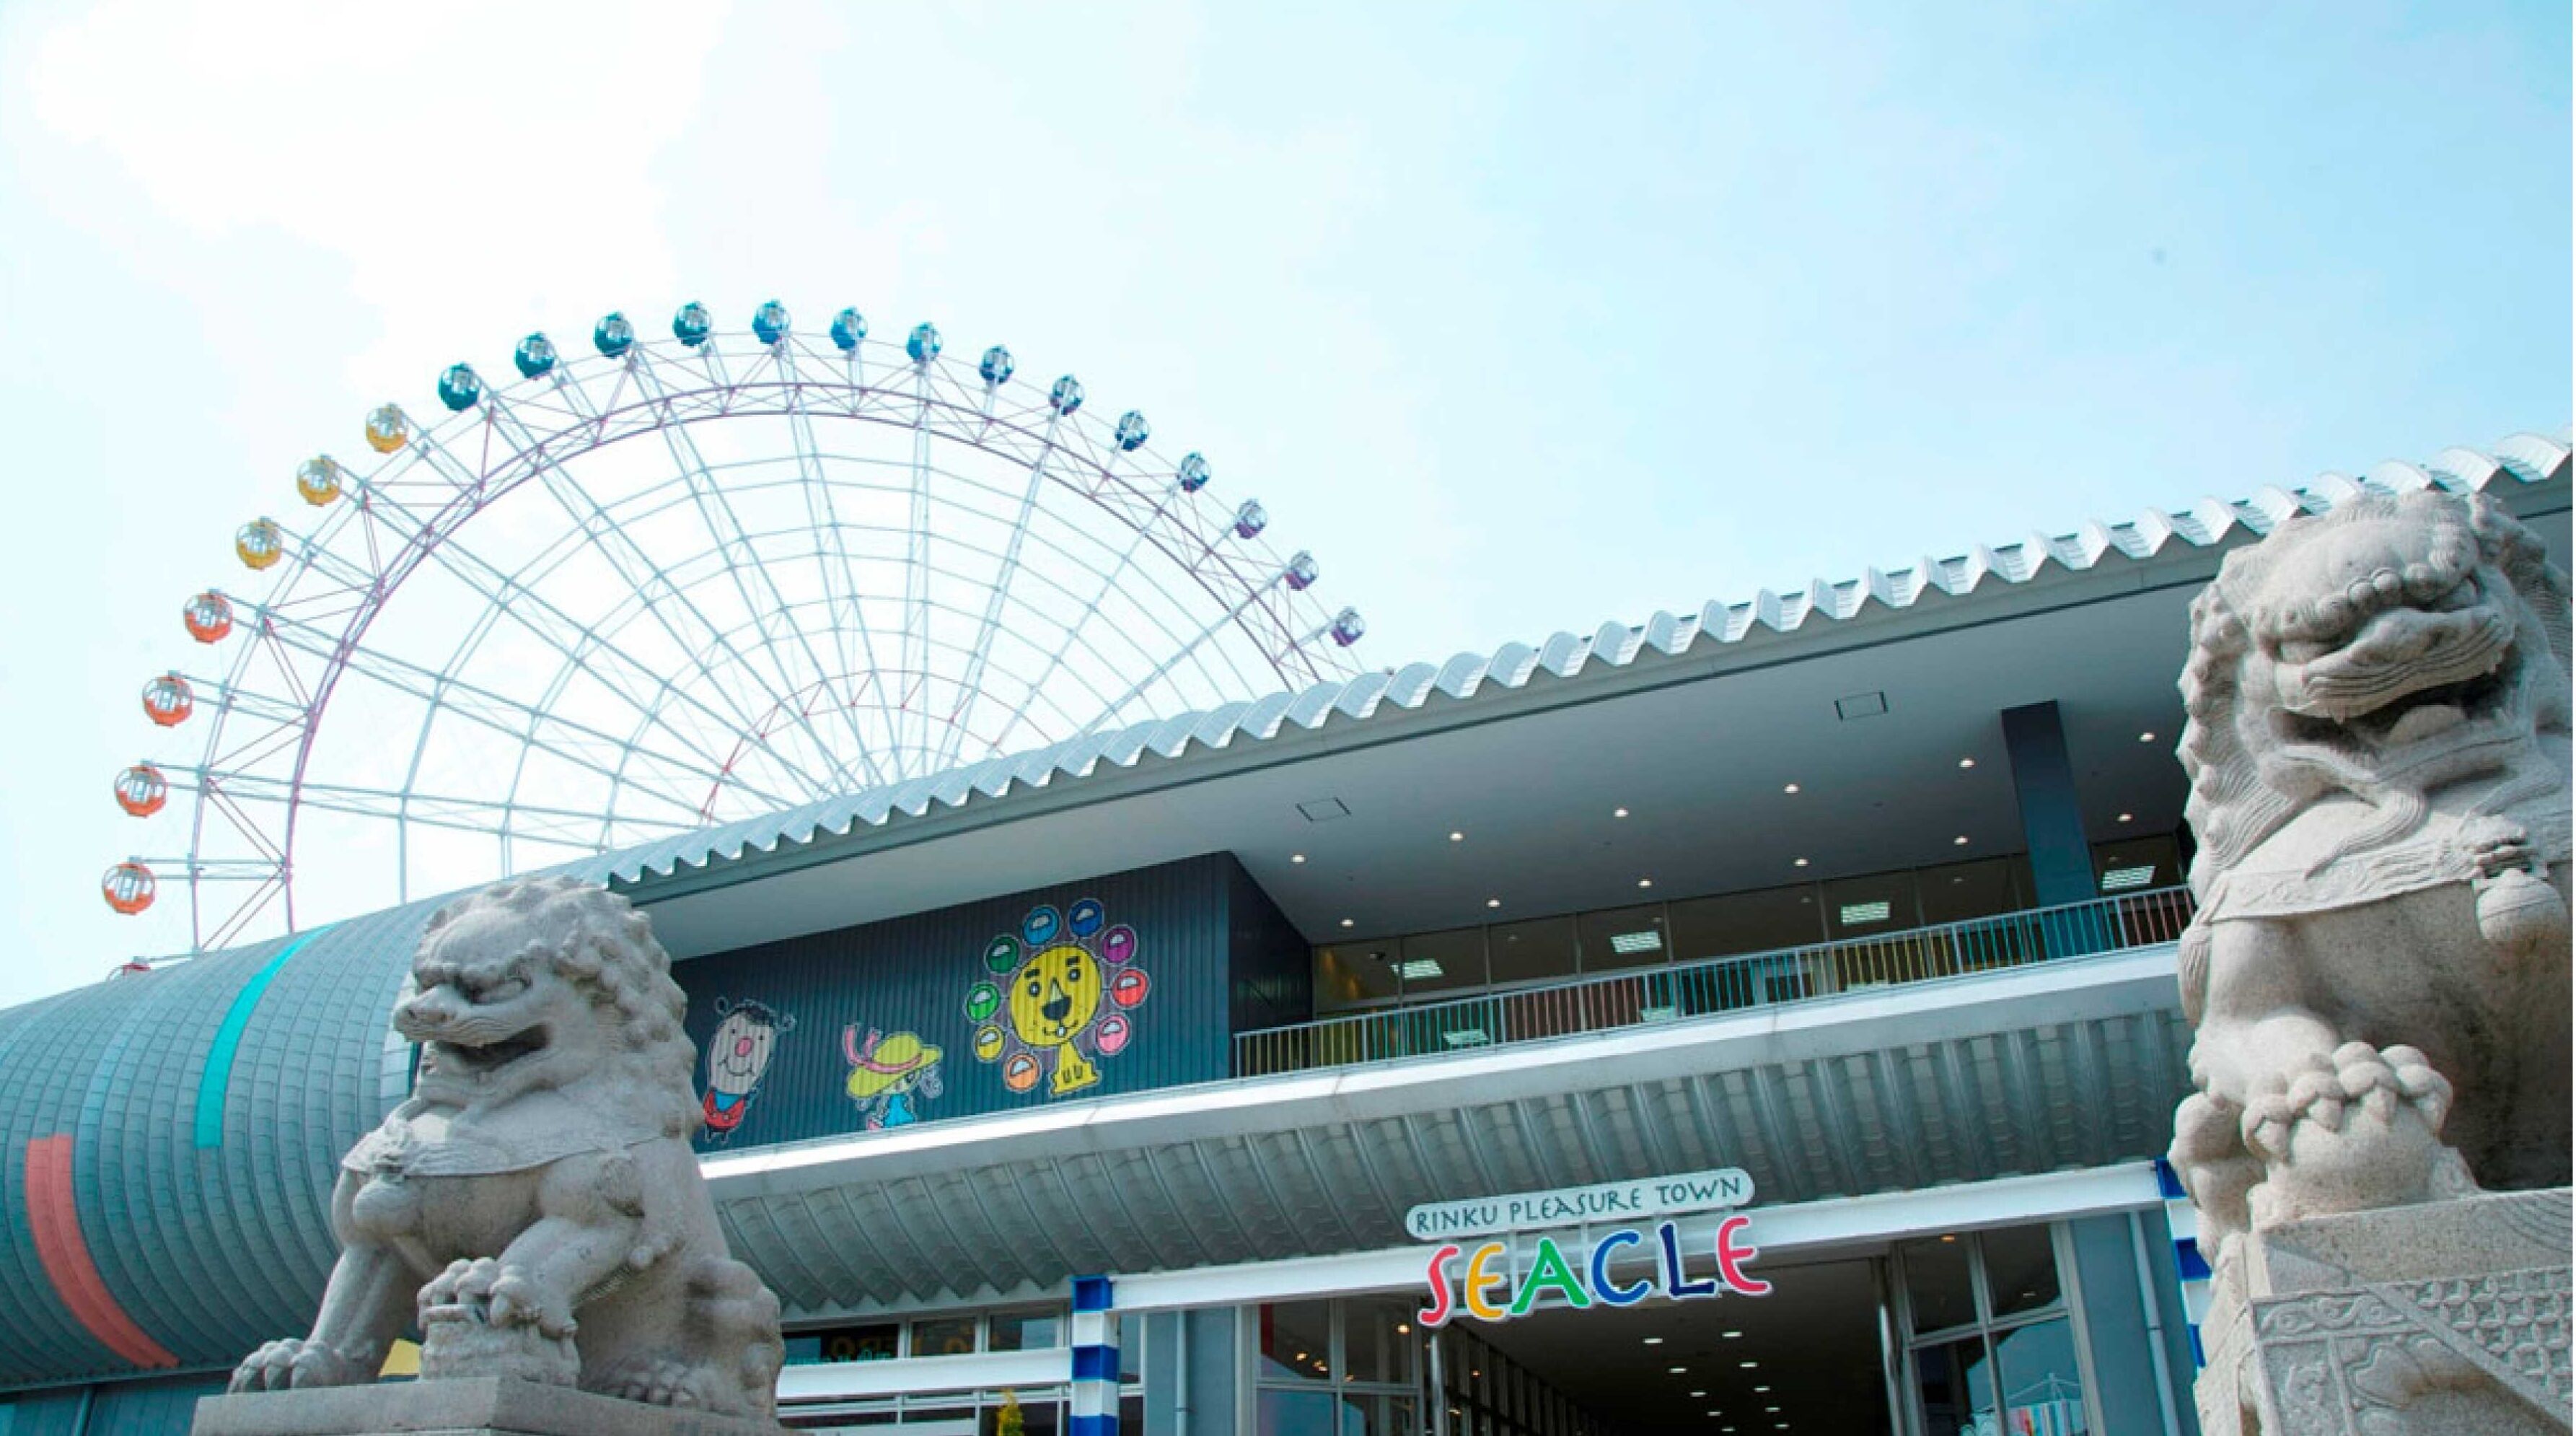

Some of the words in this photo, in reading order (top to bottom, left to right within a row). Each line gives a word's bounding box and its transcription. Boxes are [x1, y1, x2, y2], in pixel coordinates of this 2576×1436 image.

[1416, 1204, 1498, 1233] RINKU
[1509, 1188, 1642, 1224] PLEASURE
[1656, 1176, 1741, 1206] TOWN
[1417, 1215, 1772, 1326] SEACLE
